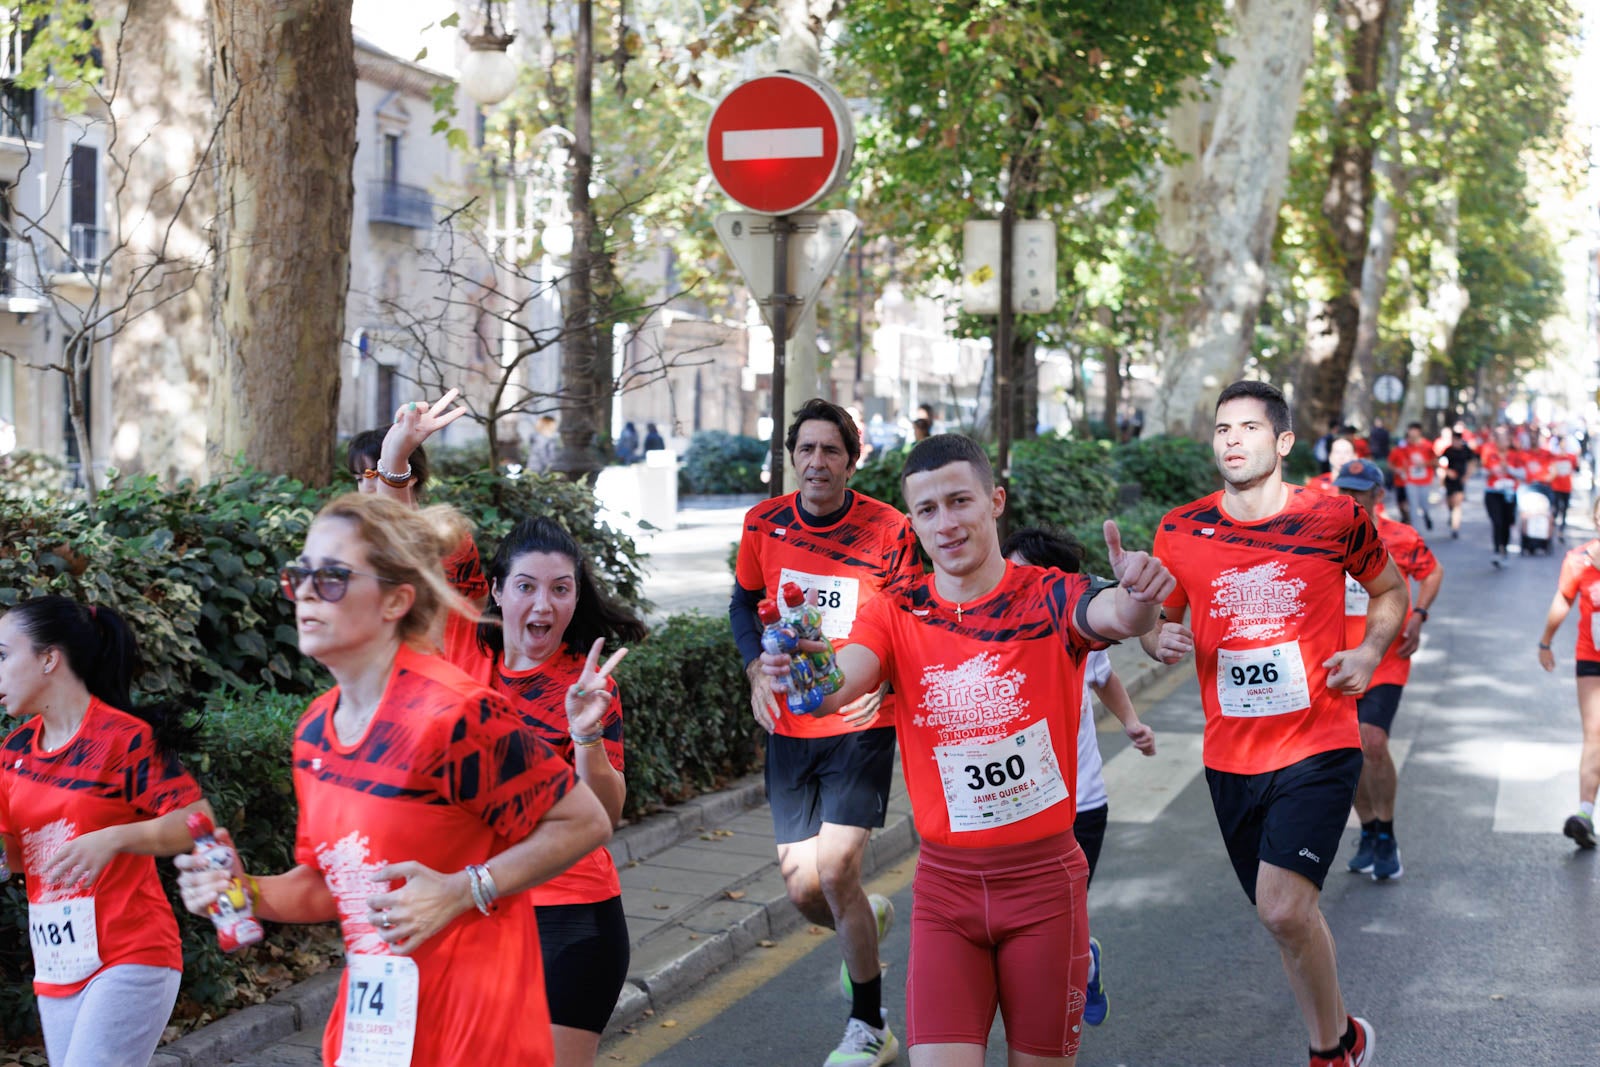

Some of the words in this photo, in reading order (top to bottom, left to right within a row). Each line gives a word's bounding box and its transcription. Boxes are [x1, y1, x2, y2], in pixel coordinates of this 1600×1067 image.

[803, 588, 841, 608] 58
[1215, 583, 1296, 603] carrera
[1219, 601, 1297, 617] cruzroja.es
[1231, 662, 1279, 686] 926
[925, 679, 1016, 708] carrera
[1246, 687, 1273, 696] IGNACIO
[926, 701, 1020, 727] cruzroja.es
[953, 729, 977, 739] NOV
[982, 725, 1007, 736] 2023
[964, 754, 1026, 791] 360
[973, 793, 997, 804] JAIME
[999, 783, 1029, 798] QUIERE
[1030, 778, 1036, 787] A
[32, 920, 76, 947] 1181
